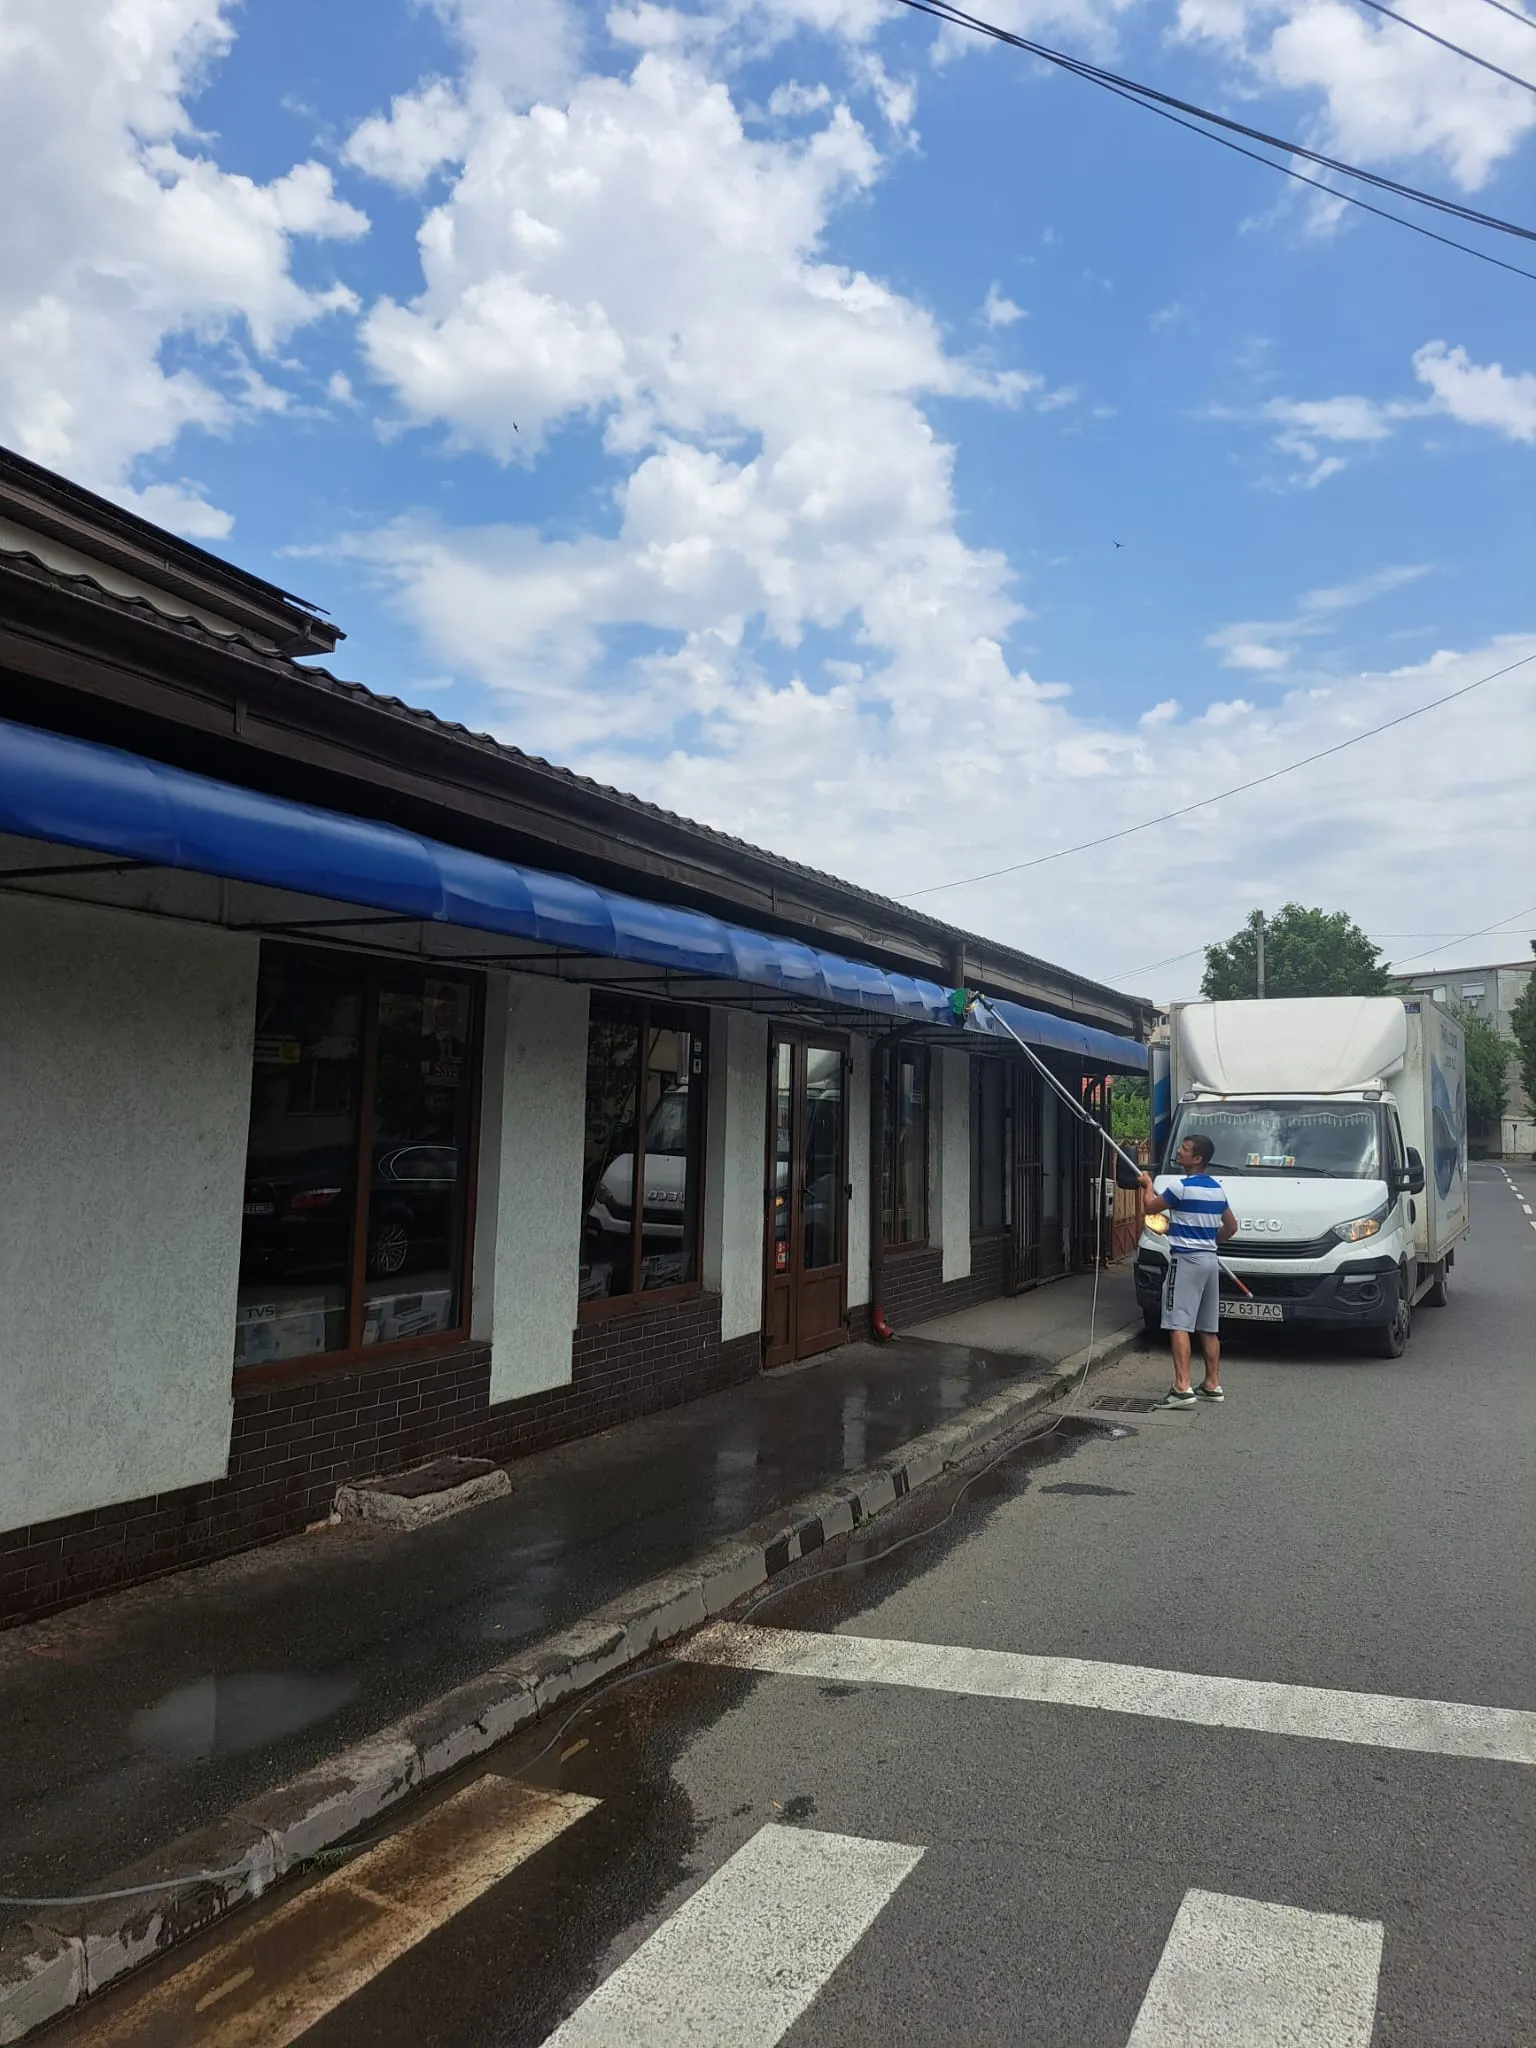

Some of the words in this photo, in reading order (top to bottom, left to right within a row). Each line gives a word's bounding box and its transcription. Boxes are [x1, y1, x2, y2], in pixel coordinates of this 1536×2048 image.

[1240, 1218, 1282, 1232] ECO
[245, 1305, 274, 1319] TVS
[1219, 1302, 1235, 1313] BZ
[1239, 1303, 1253, 1315] 63
